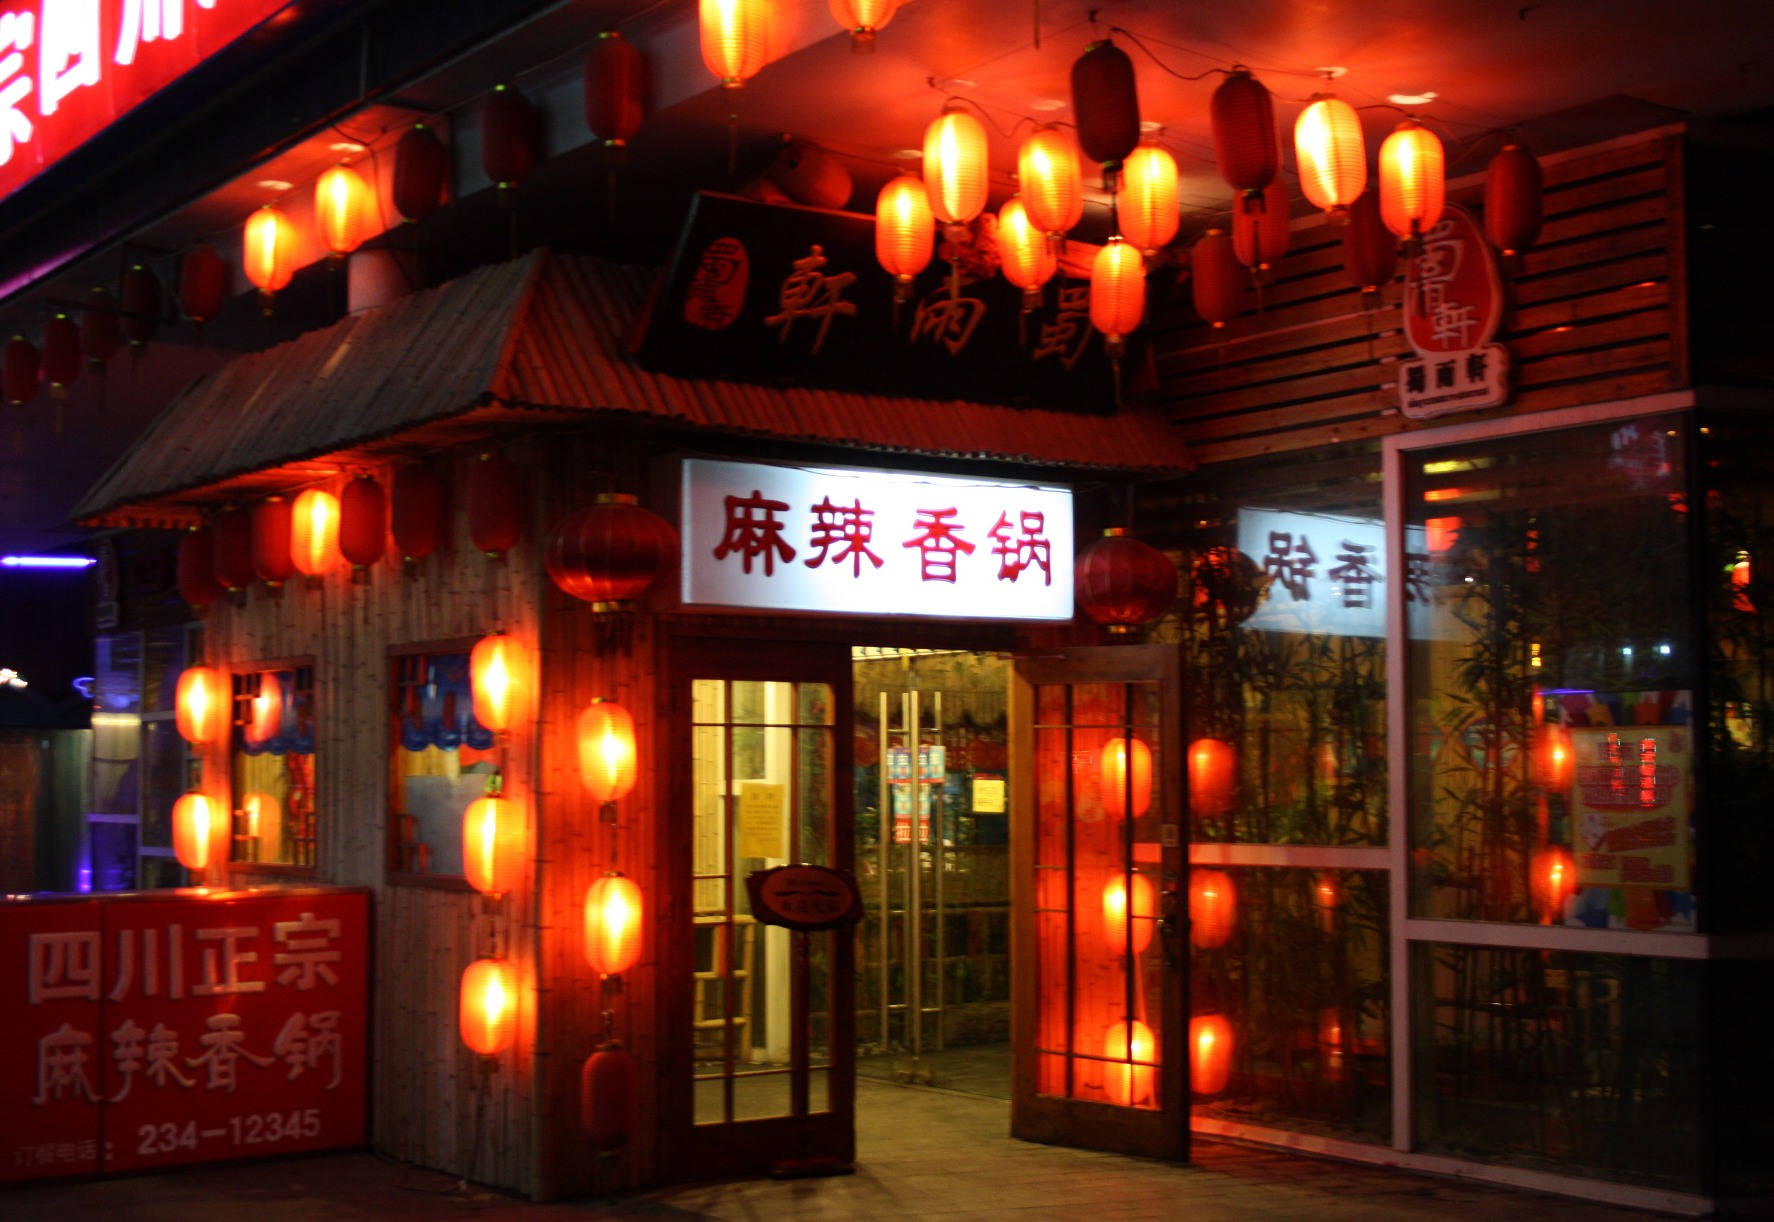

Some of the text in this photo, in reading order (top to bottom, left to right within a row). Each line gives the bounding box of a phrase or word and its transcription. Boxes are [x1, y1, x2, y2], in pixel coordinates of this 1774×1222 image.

[714, 490, 1051, 586] 麻辣香锅
[29, 912, 341, 1004] 四川正宗
[32, 1010, 342, 1105] 麻辣香锅
[138, 1110, 322, 1154] 234-12345
